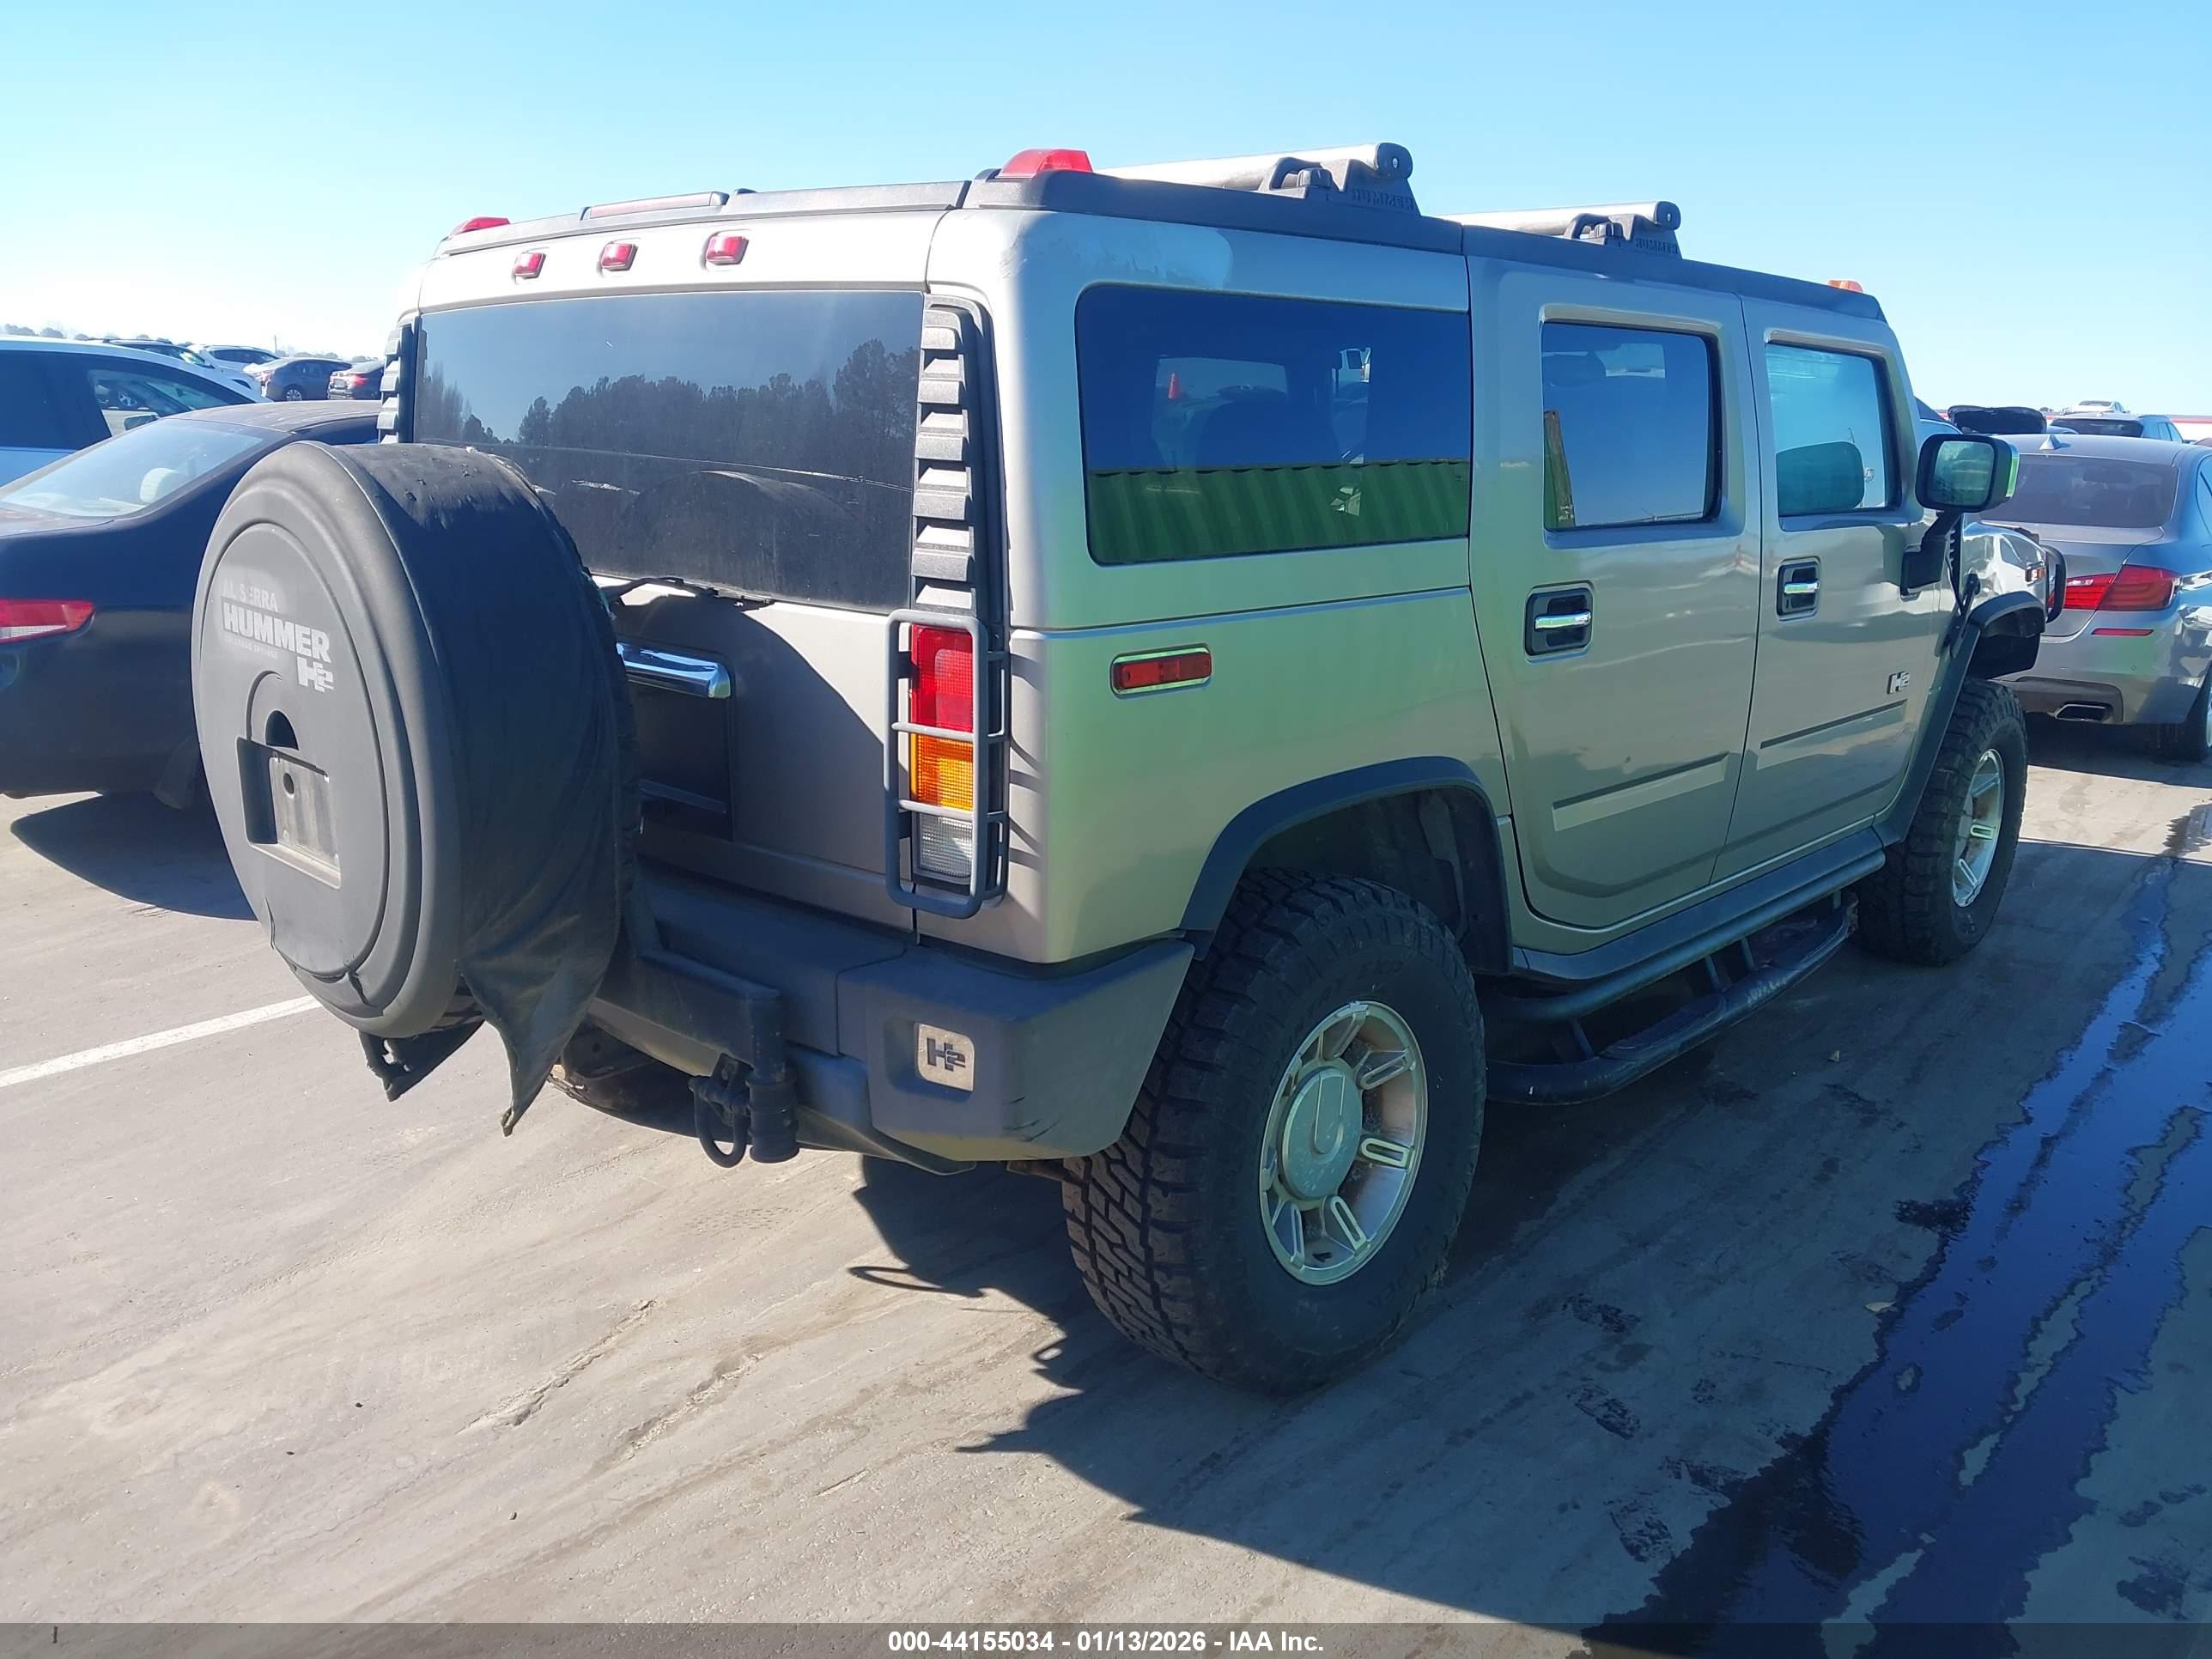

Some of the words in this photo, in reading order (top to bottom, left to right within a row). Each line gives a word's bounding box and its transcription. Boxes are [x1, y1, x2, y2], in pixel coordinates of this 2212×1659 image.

[222, 602, 331, 664] HUMMER
[296, 656, 334, 693] H2
[1887, 671, 1910, 695] H2
[927, 1037, 966, 1073] H2
